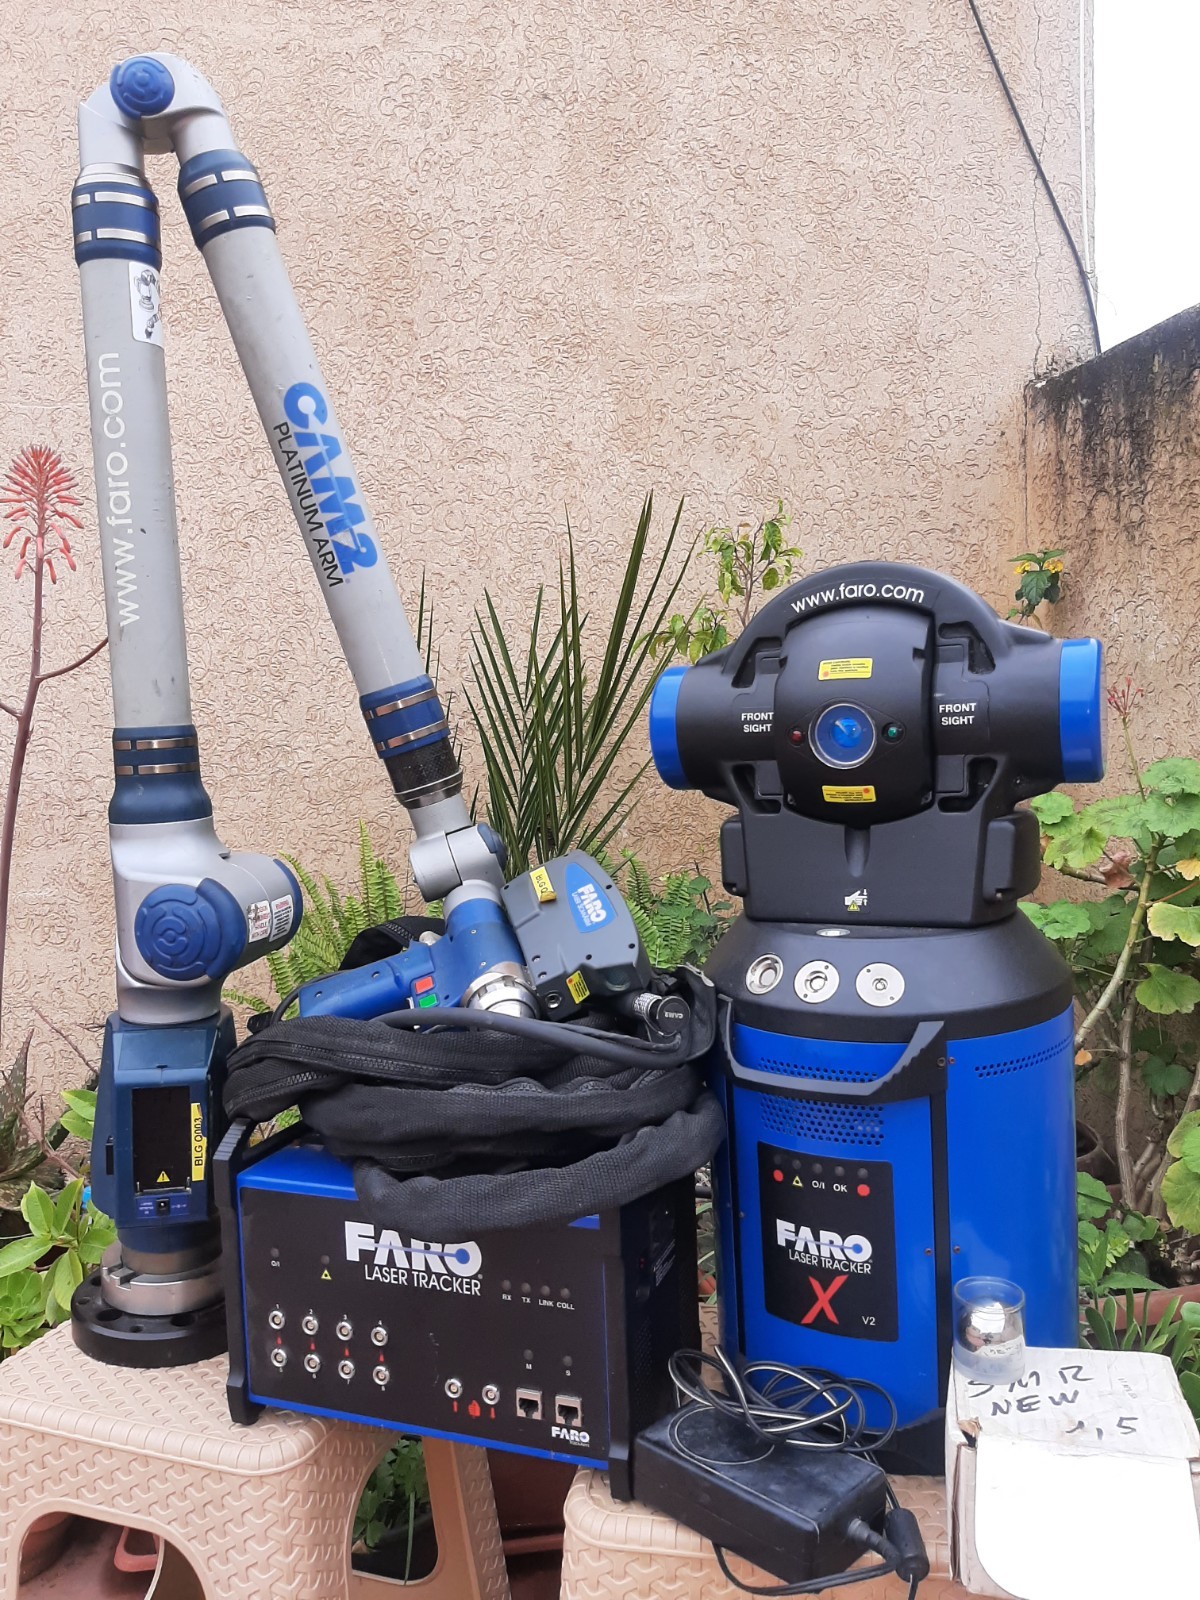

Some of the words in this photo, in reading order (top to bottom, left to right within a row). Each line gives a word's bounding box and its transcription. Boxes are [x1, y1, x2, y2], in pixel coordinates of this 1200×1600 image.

[97, 352, 141, 628] www.faro.com
[283, 381, 378, 576] CAM2
[273, 421, 324, 533] PLATINUM
[312, 537, 344, 588] ARM
[790, 583, 925, 614] www.faro.com
[741, 712, 774, 722] FRONT
[939, 702, 977, 714] FRONT
[941, 715, 975, 726] SIGHT
[743, 723, 772, 733] SIGHT
[577, 883, 607, 922] FARO
[194, 1146, 203, 1166] BLG
[833, 1184, 848, 1193] OK
[344, 1220, 482, 1277] FARO
[776, 1218, 873, 1263] FARO
[789, 1249, 818, 1267] LASER
[821, 1256, 872, 1275] TRACKER
[364, 1264, 408, 1286] LASER
[411, 1270, 481, 1296] TRACKER
[502, 1293, 512, 1301] RX
[538, 1299, 554, 1307] LINK
[556, 1301, 575, 1310] COLL
[801, 1274, 849, 1325] X
[861, 1315, 876, 1326] V2
[990, 1389, 1079, 1416] NEW
[551, 1426, 590, 1443] FARO
